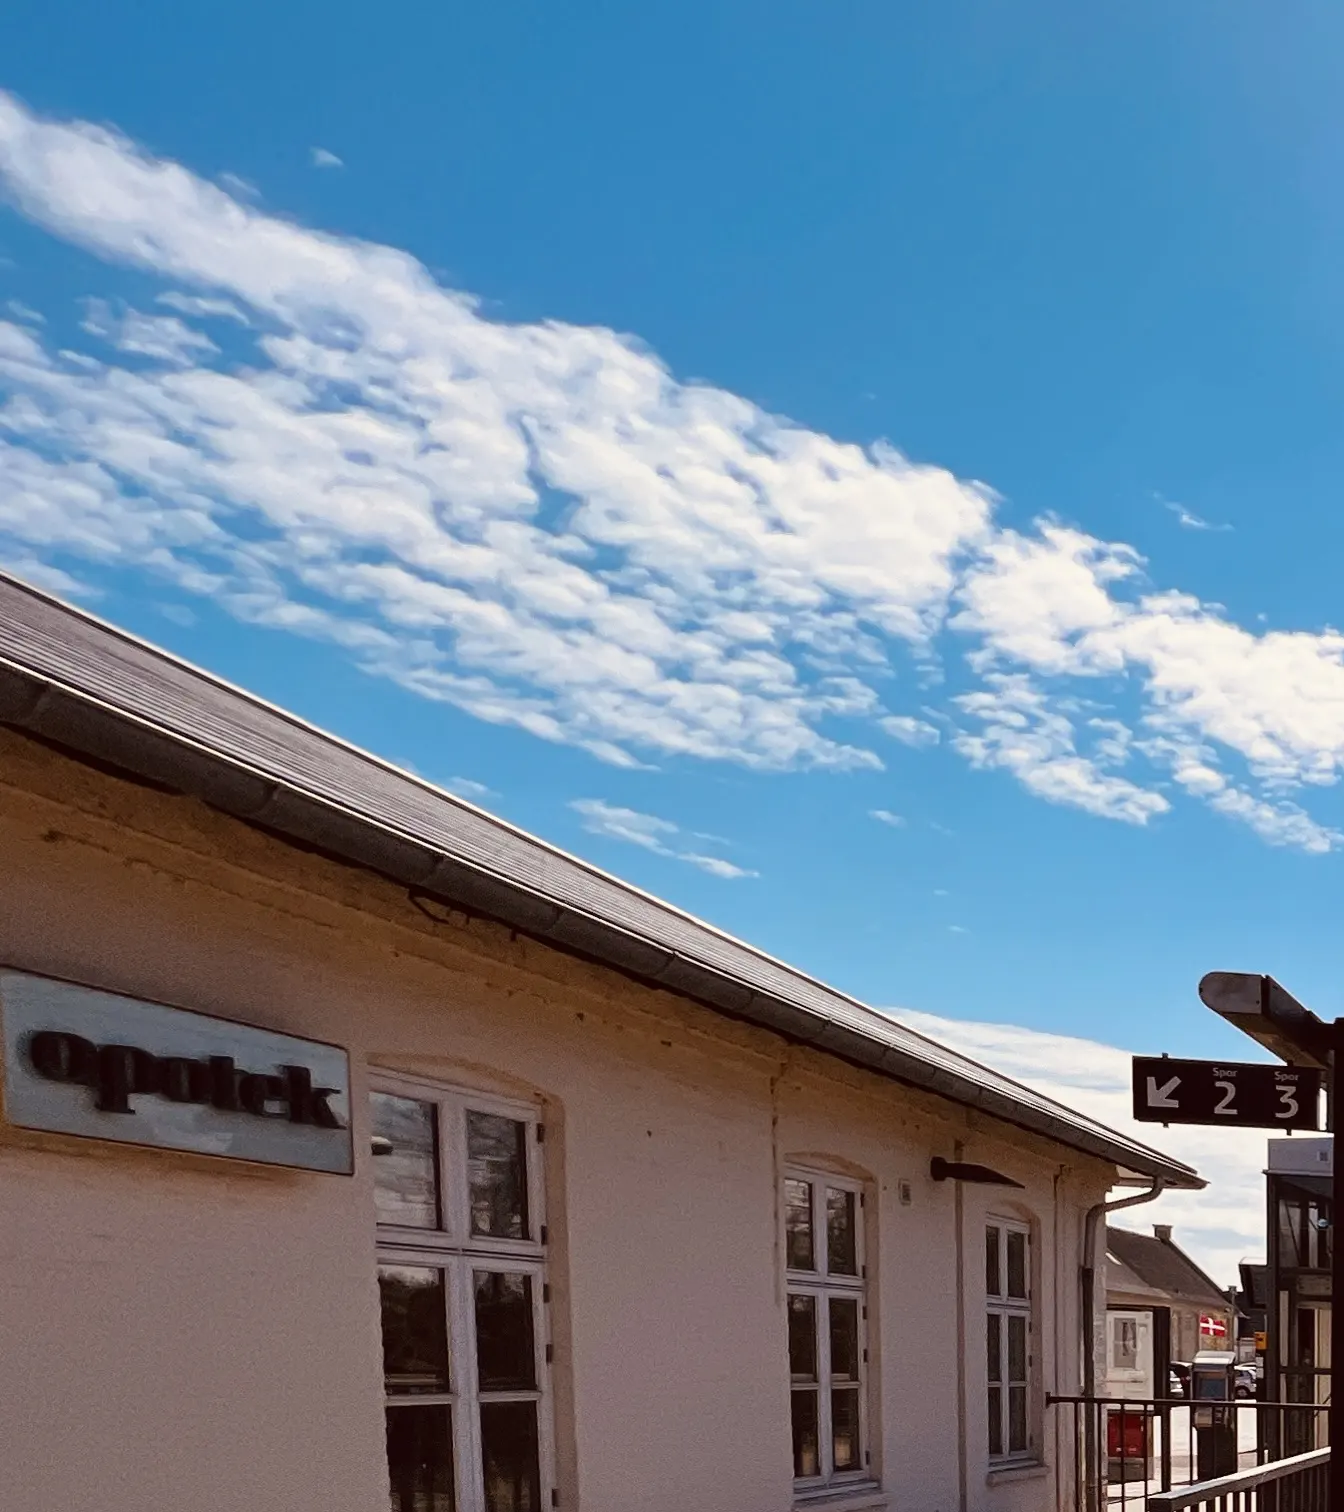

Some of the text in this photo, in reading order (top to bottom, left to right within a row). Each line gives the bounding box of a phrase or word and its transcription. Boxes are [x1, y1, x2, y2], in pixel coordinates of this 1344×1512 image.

[1212, 1067, 1299, 1082] Spor Spor
[1214, 1081, 1299, 1119] 2 3
